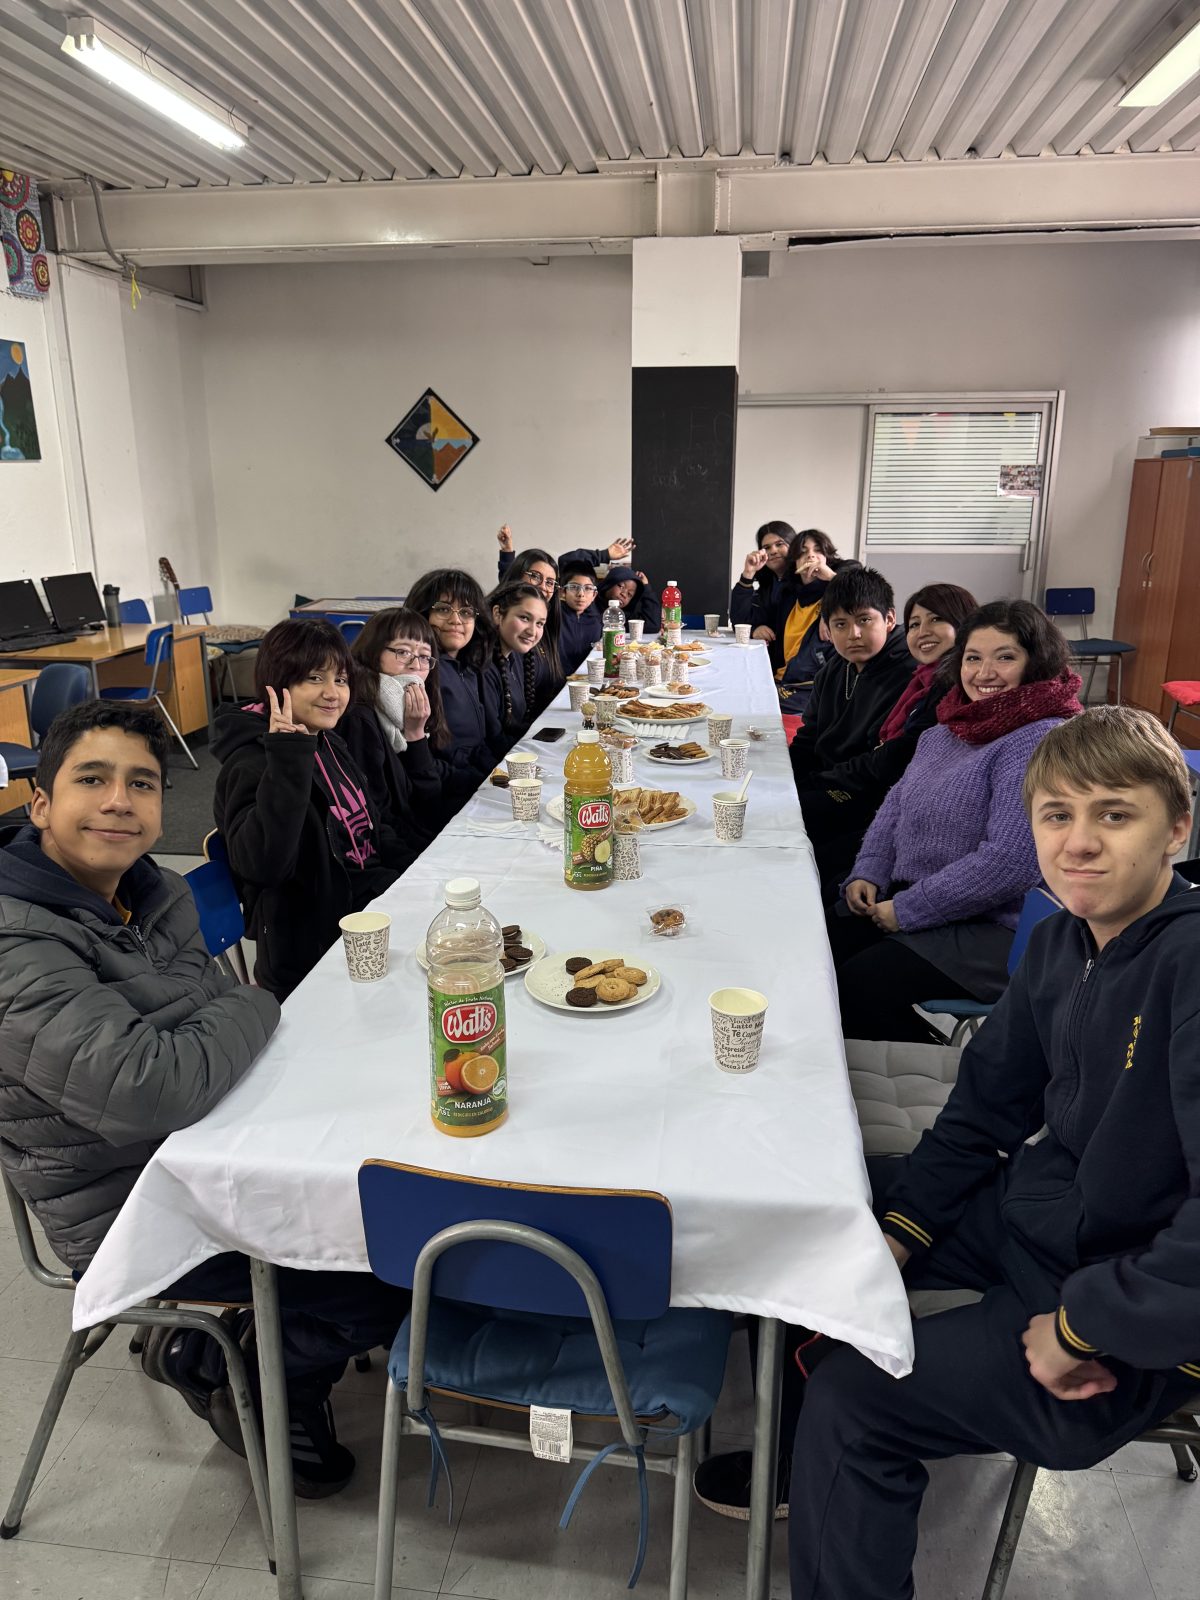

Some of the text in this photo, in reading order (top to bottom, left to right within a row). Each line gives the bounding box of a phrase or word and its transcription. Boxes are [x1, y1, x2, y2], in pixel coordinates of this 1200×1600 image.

[447, 1006, 493, 1038] Watt's
[732, 1029, 741, 1038] Té
[454, 1096, 492, 1109] NARANJA
